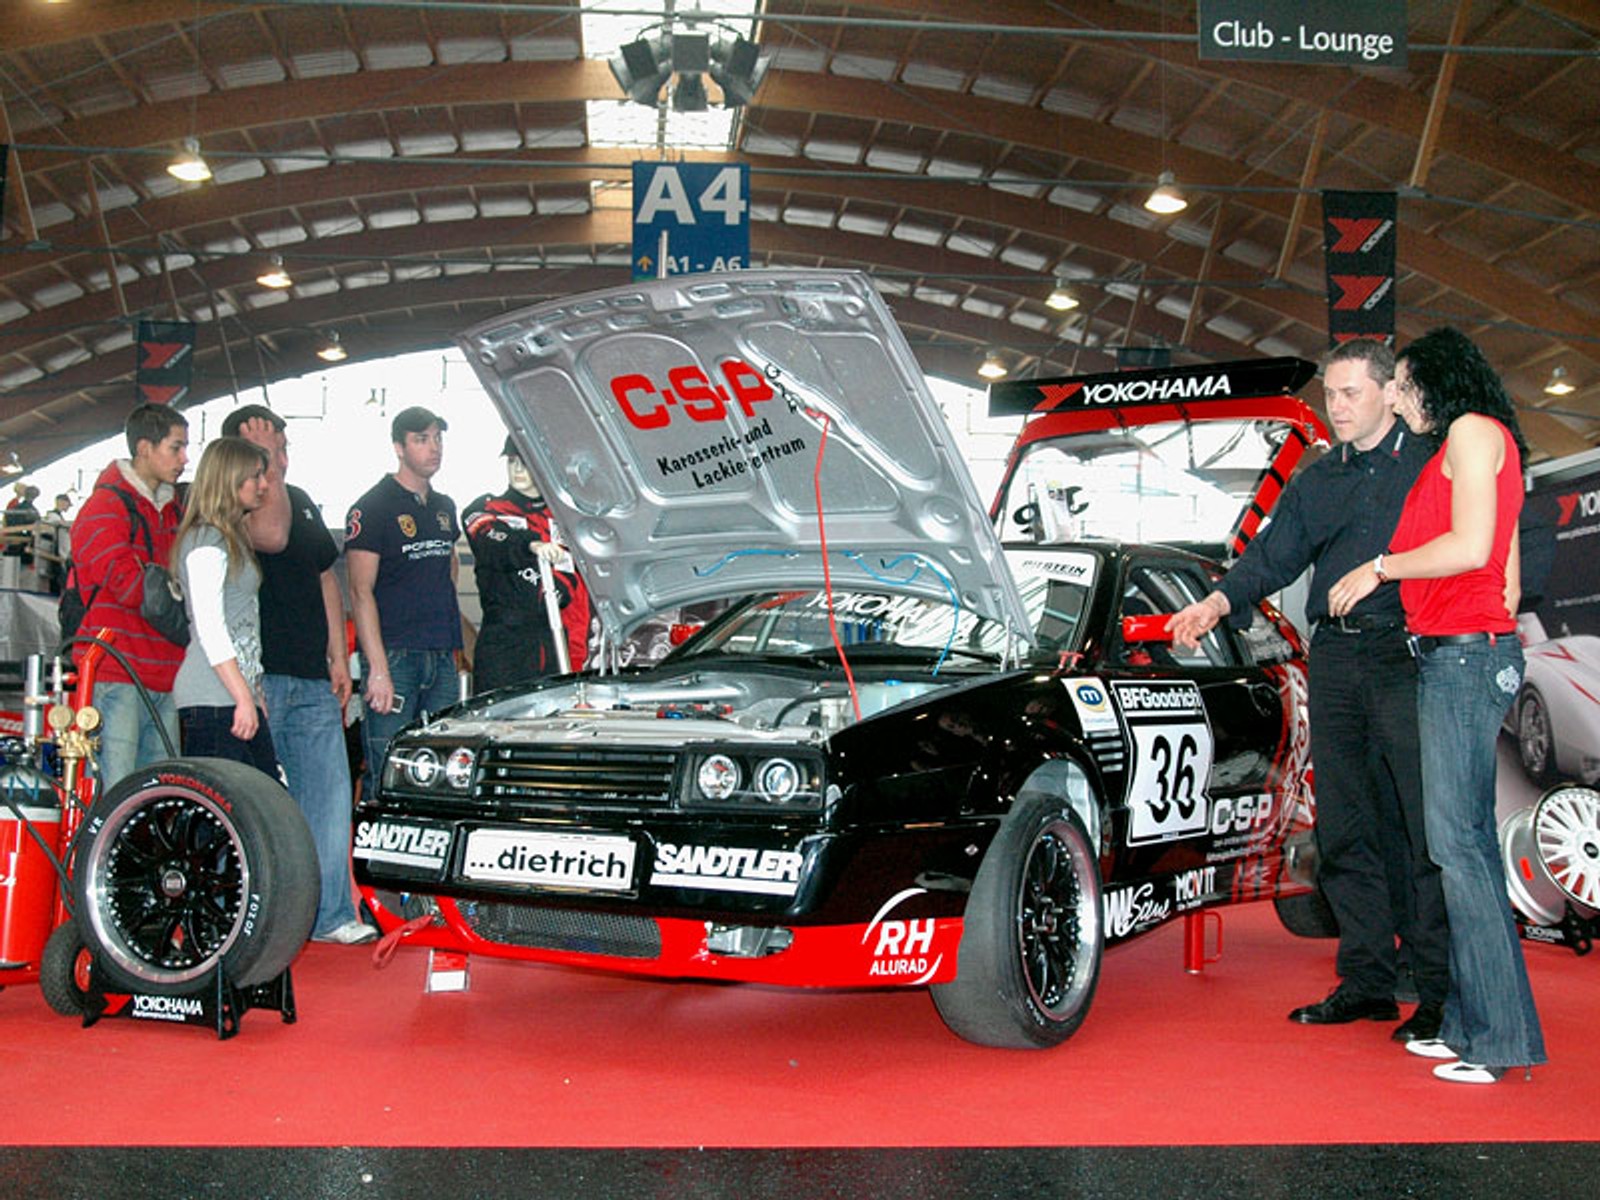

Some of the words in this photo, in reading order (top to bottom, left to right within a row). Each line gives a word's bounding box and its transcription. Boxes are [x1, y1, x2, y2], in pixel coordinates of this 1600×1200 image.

[1213, 20, 1274, 48] Club
[1299, 25, 1394, 60] Lounge
[635, 166, 747, 225] A4
[711, 255, 741, 273] A6
[1082, 374, 1232, 405] YOKOHAMA
[1579, 491, 1600, 517] YO
[1118, 687, 1202, 710] BFGoodrich
[1145, 733, 1199, 824] 36
[354, 821, 451, 857] SANDTLER
[654, 842, 804, 882] SANDTLER
[874, 917, 936, 957] RH
[869, 957, 928, 976] ALURAD
[133, 994, 203, 1016] YOKOHAMA
